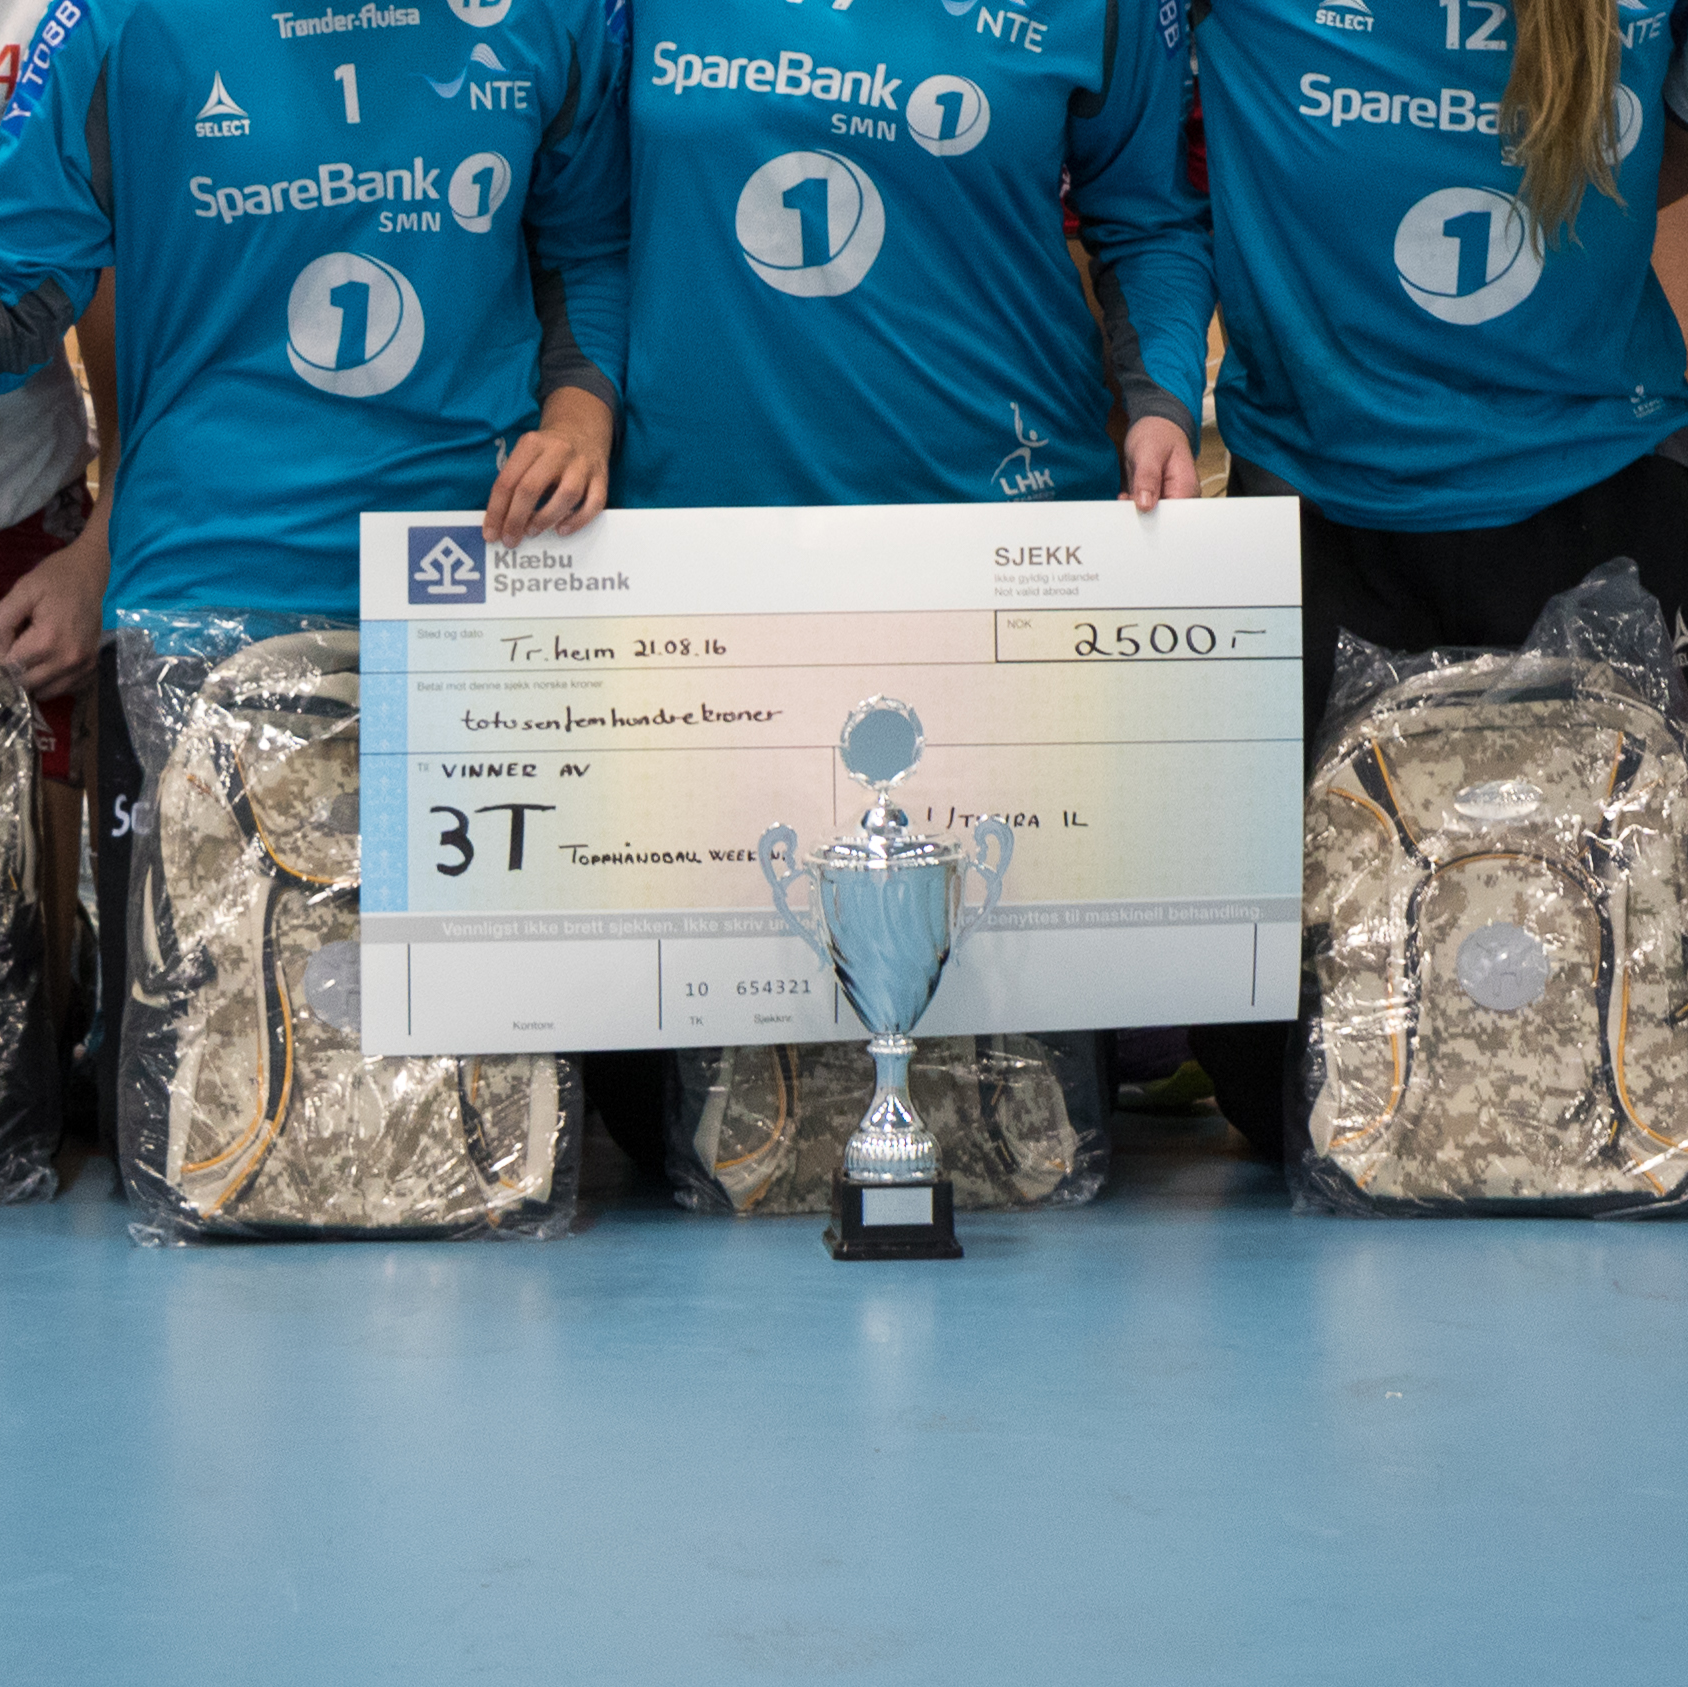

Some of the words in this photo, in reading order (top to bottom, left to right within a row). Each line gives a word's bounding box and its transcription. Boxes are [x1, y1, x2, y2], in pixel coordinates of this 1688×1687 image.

[976, 7, 1048, 53] NTE
[1315, 10, 1375, 32] SELECT
[651, 41, 903, 110] SpareBank
[333, 62, 361, 124] 1
[469, 81, 531, 110] NTE
[1298, 72, 1505, 136] SpareBa
[195, 119, 251, 137] SELECT
[830, 113, 898, 142] SMN
[189, 156, 441, 224] SpareBank
[378, 211, 441, 233] SMN
[999, 468, 1055, 496] LHK
[494, 549, 573, 571] Klæbu
[994, 546, 1083, 567] SJEKK
[493, 573, 631, 595] Sparebank
[1042, 586, 1079, 596] abroad
[444, 631, 458, 642] og
[461, 628, 483, 640] dato
[1007, 619, 1032, 629] NOK
[469, 681, 501, 691] denne
[570, 679, 603, 690] kroner
[441, 762, 538, 779] VINNER
[559, 762, 591, 778] AV
[1064, 909, 1082, 923] til
[1085, 907, 1164, 922] maskinell
[442, 921, 519, 939] Vennligst
[523, 920, 559, 935] ikke
[563, 919, 604, 934] brett
[684, 917, 719, 932] Ikke
[723, 916, 763, 932] skriv
[684, 981, 709, 998] 10
[736, 979, 812, 996] 654321
